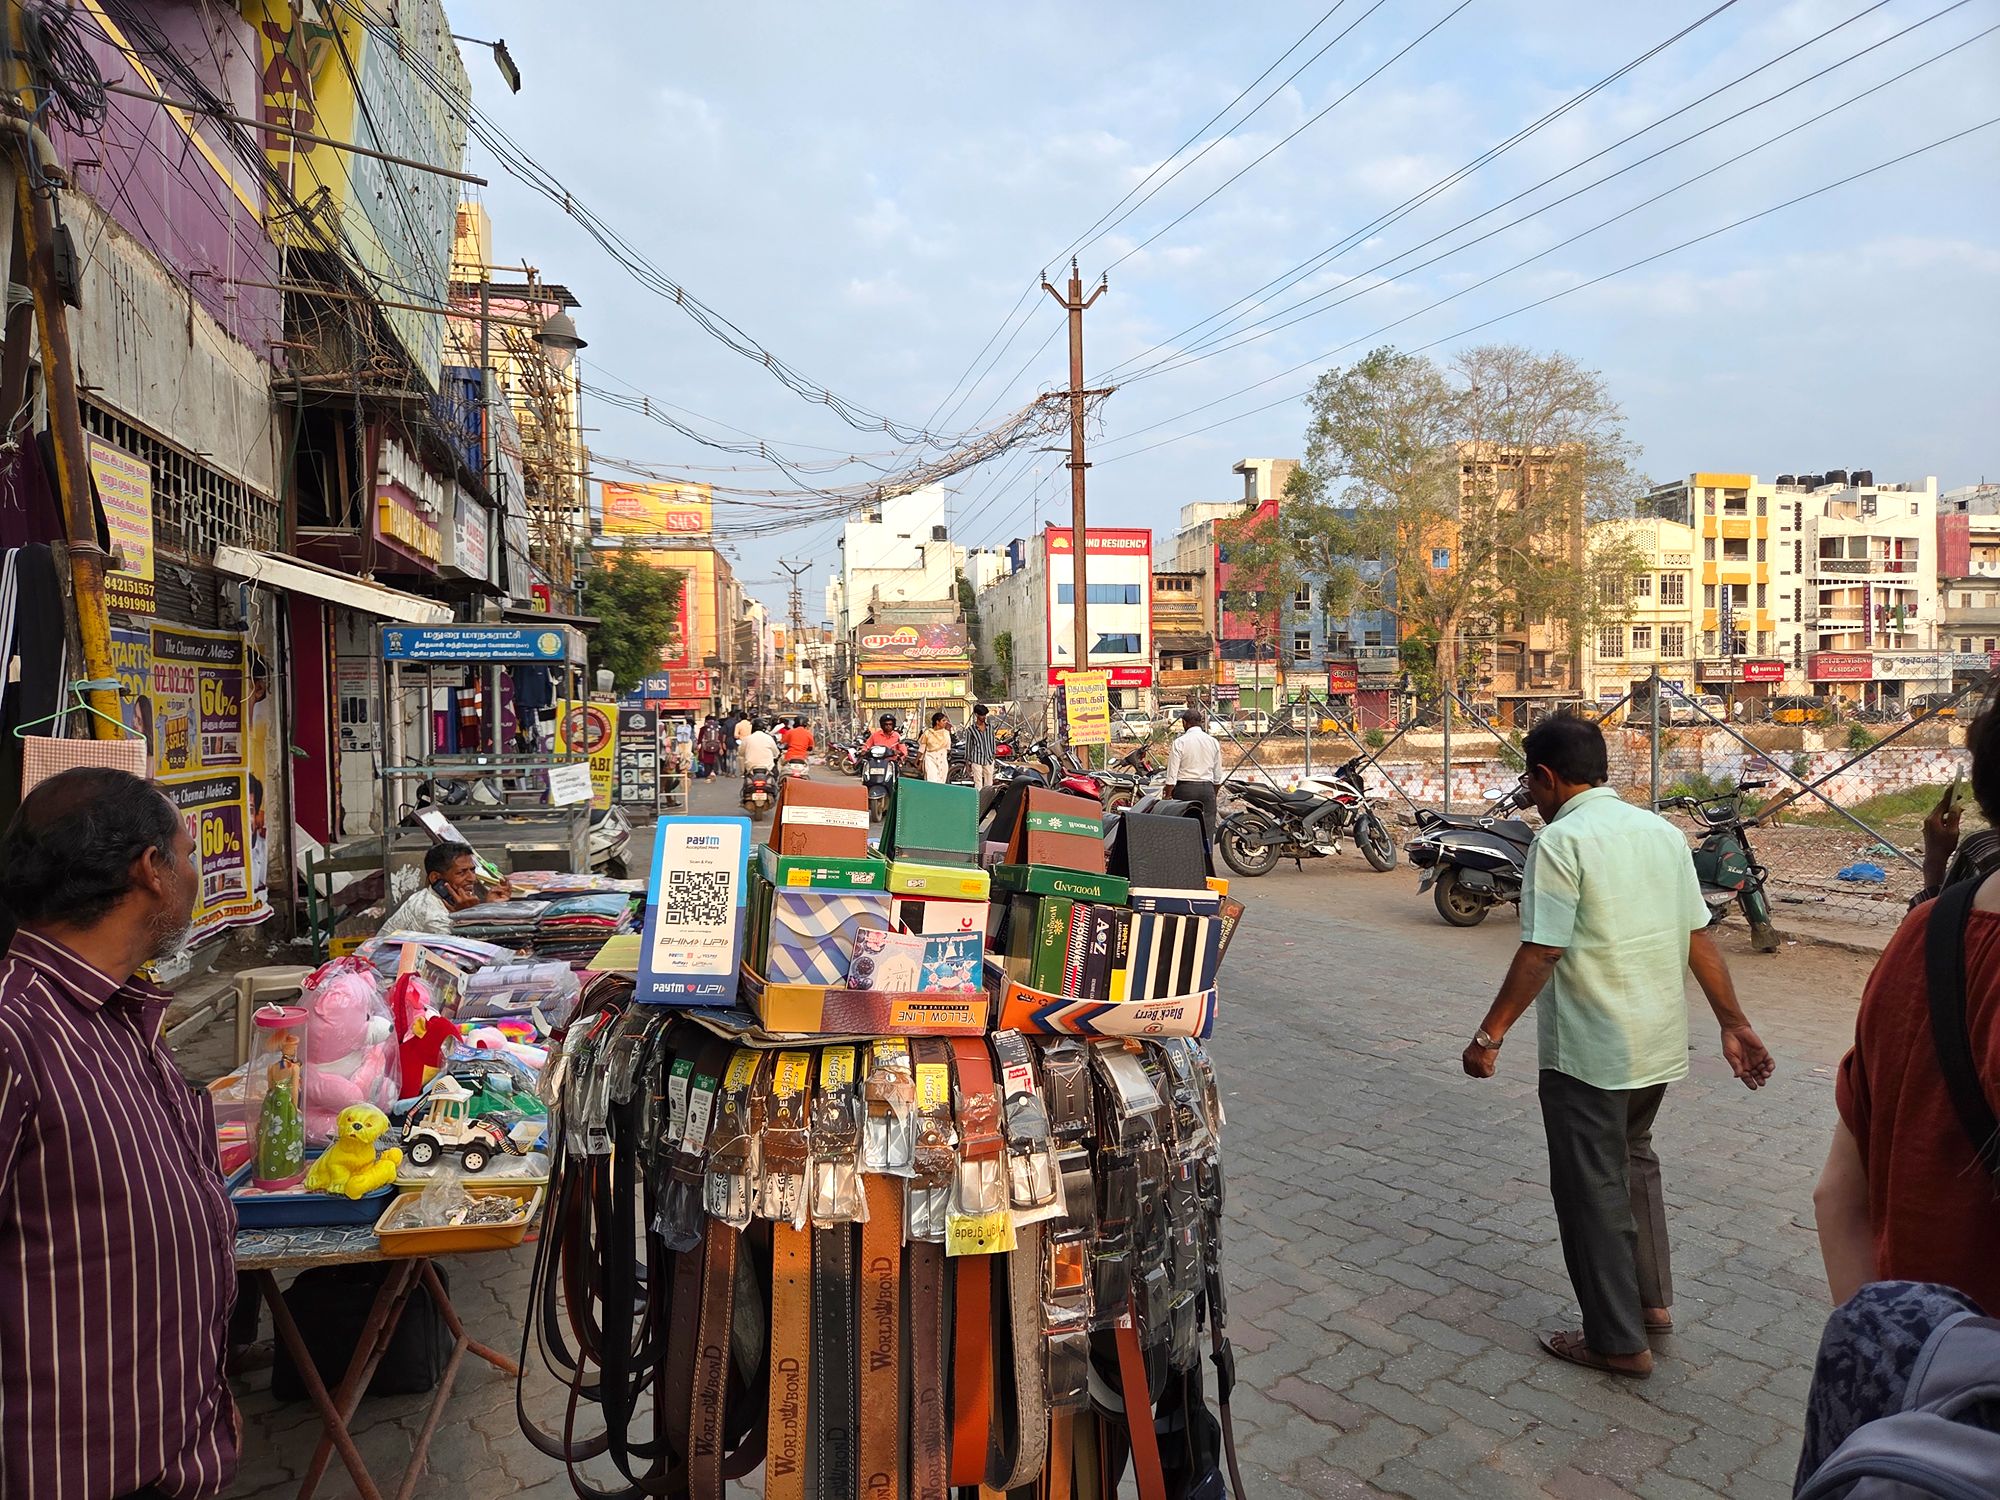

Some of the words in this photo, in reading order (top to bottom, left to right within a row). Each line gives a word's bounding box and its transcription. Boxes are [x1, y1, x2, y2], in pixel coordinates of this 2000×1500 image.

[1102, 539, 1147, 548] RESIDENCY
[1069, 821, 1099, 832] WOODLAND
[203, 817, 240, 857] 60%
[1054, 880, 1101, 896] WOODLAND
[1121, 924, 1129, 956] HARLEY
[653, 982, 684, 993] paytm
[696, 984, 722, 993] UPI
[898, 1011, 927, 1023] LINE
[931, 1011, 976, 1024] YELLOW
[1133, 1009, 1158, 1021] Berry
[1159, 1007, 1184, 1020] Black
[954, 1226, 984, 1240] grade
